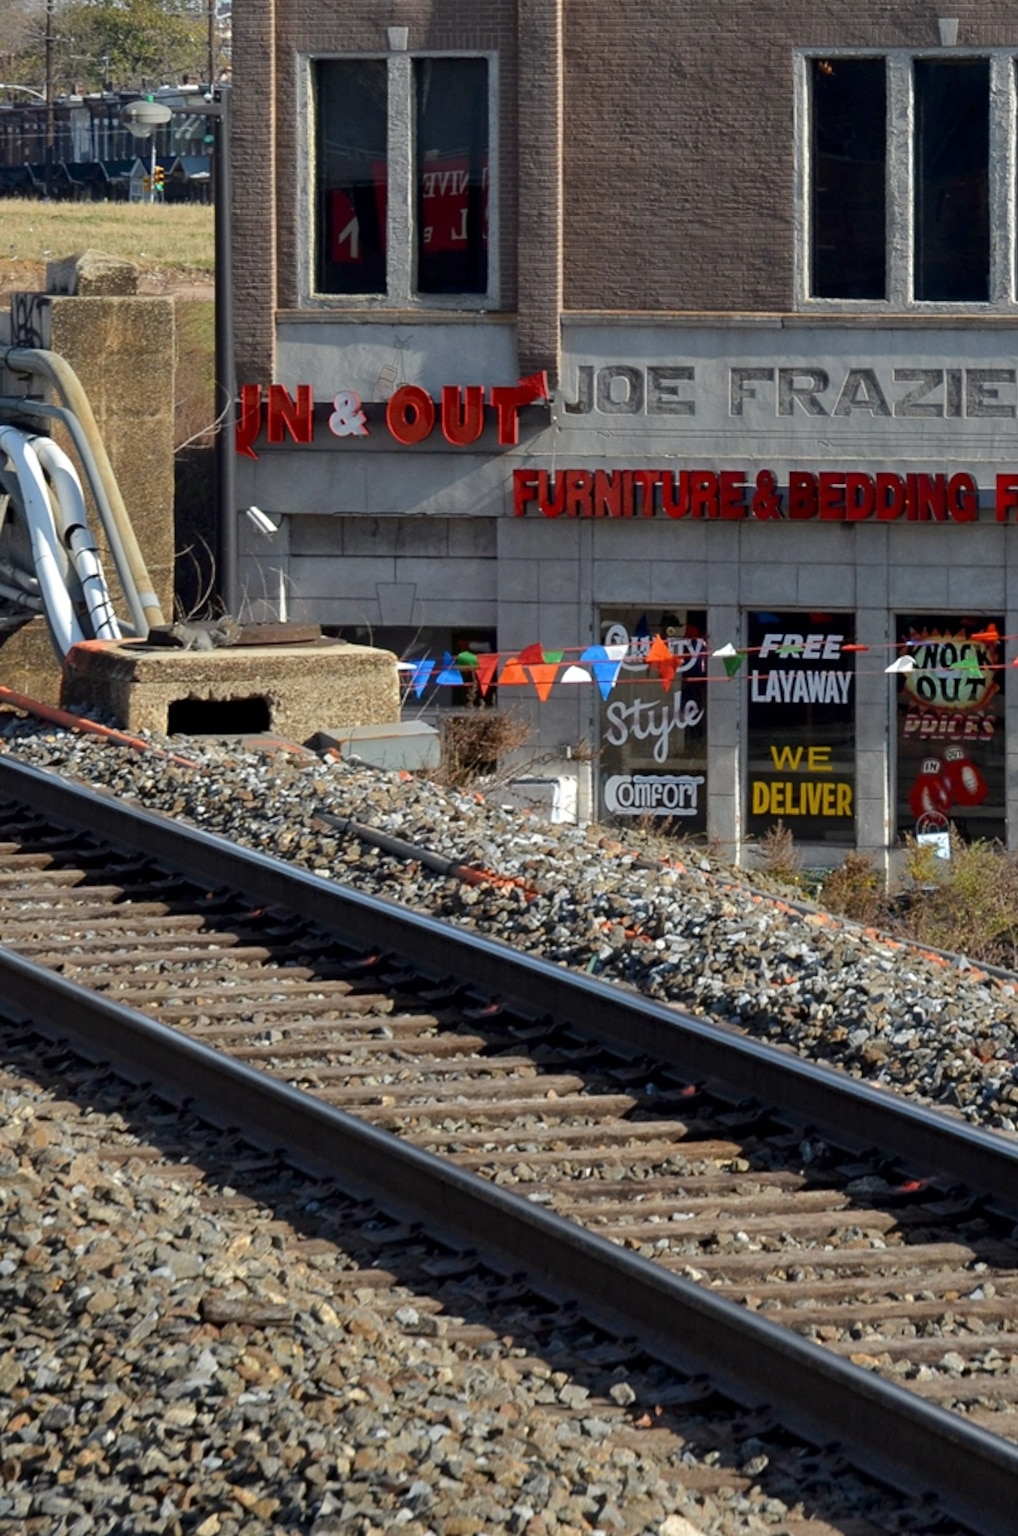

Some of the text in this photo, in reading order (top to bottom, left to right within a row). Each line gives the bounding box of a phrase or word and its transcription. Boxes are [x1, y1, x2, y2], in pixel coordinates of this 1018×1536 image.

[329, 389, 371, 437] &
[386, 370, 549, 447] OUT
[563, 365, 695, 417] JOE
[513, 469, 748, 520] FURNITURE
[752, 468, 785, 522] &
[788, 470, 979, 523] BEDDING
[758, 633, 844, 660] FREE
[751, 669, 854, 705] LAYAWAY
[916, 674, 986, 703] OUT
[603, 690, 705, 764] Style
[903, 713, 997, 741] PRICES
[770, 745, 833, 772] WE
[752, 780, 854, 816] DELIVER
